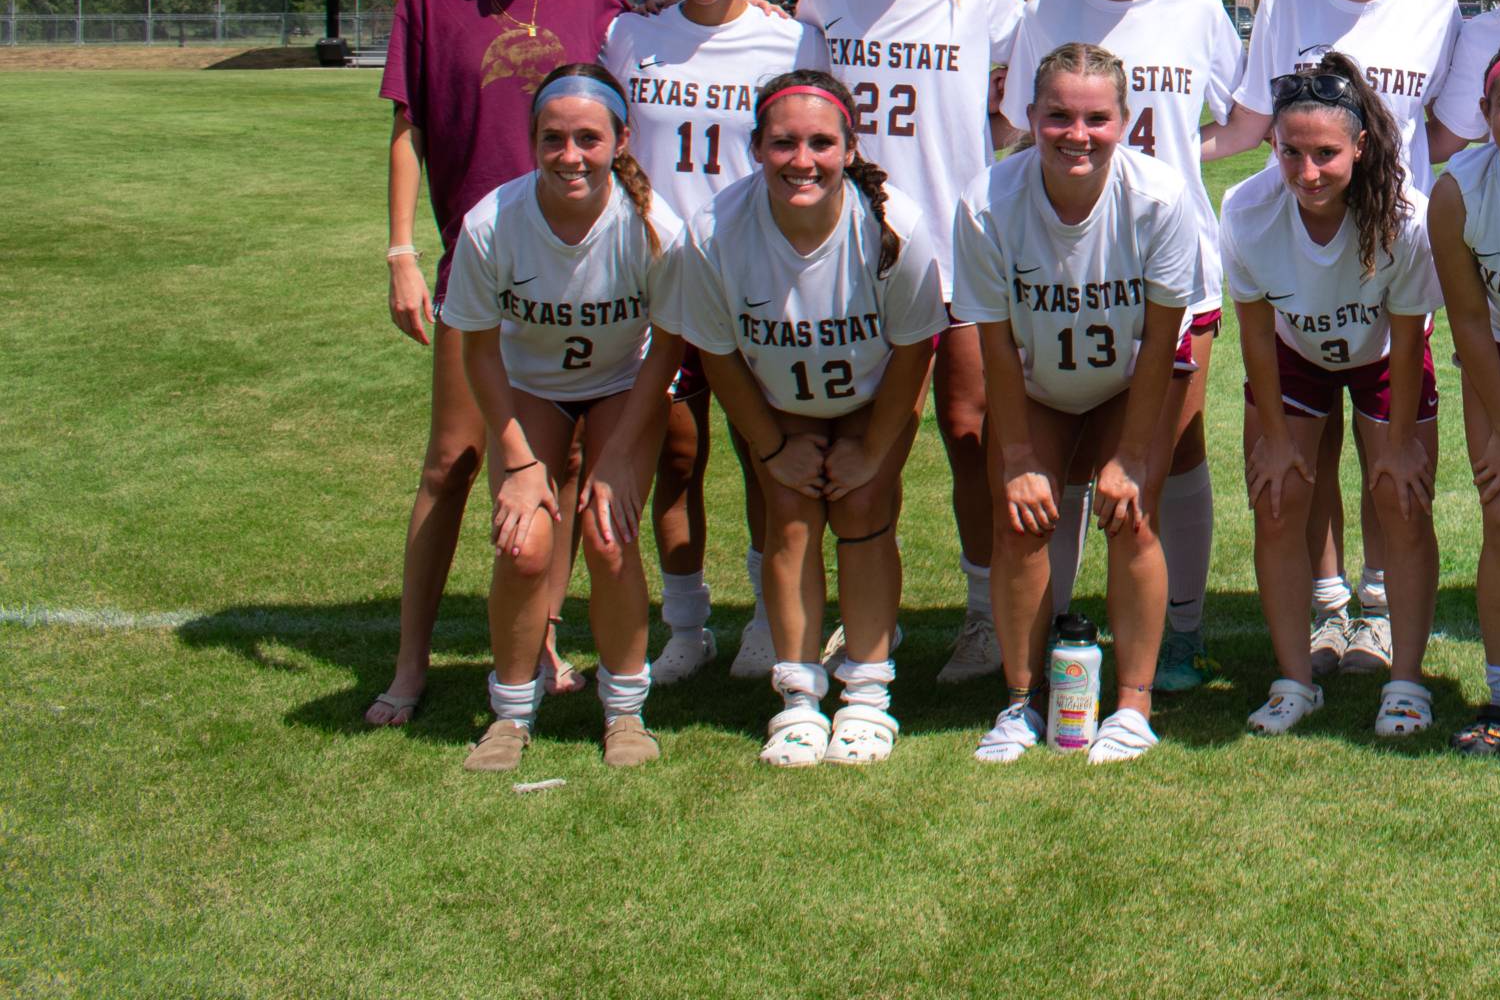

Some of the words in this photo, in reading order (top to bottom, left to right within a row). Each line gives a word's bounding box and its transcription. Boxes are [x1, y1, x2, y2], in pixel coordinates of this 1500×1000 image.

[888, 42, 960, 72] STATE
[630, 77, 700, 107] TEXAS
[706, 84, 758, 111] STA
[1131, 66, 1192, 95] STATE
[1366, 66, 1426, 98] STATE
[854, 81, 917, 137] 22
[675, 121, 721, 175] 11
[1128, 107, 1155, 157] 4
[499, 289, 571, 327] TEXAS
[580, 292, 643, 327] STAT
[1013, 278, 1080, 314] TEXAS
[739, 313, 811, 347] TEXAS
[1280, 311, 1331, 334] XAS
[1336, 301, 1383, 328] STAT
[562, 336, 594, 370] 2
[1058, 324, 1117, 370] 13
[1320, 338, 1351, 364] 3
[790, 359, 856, 401] 12
